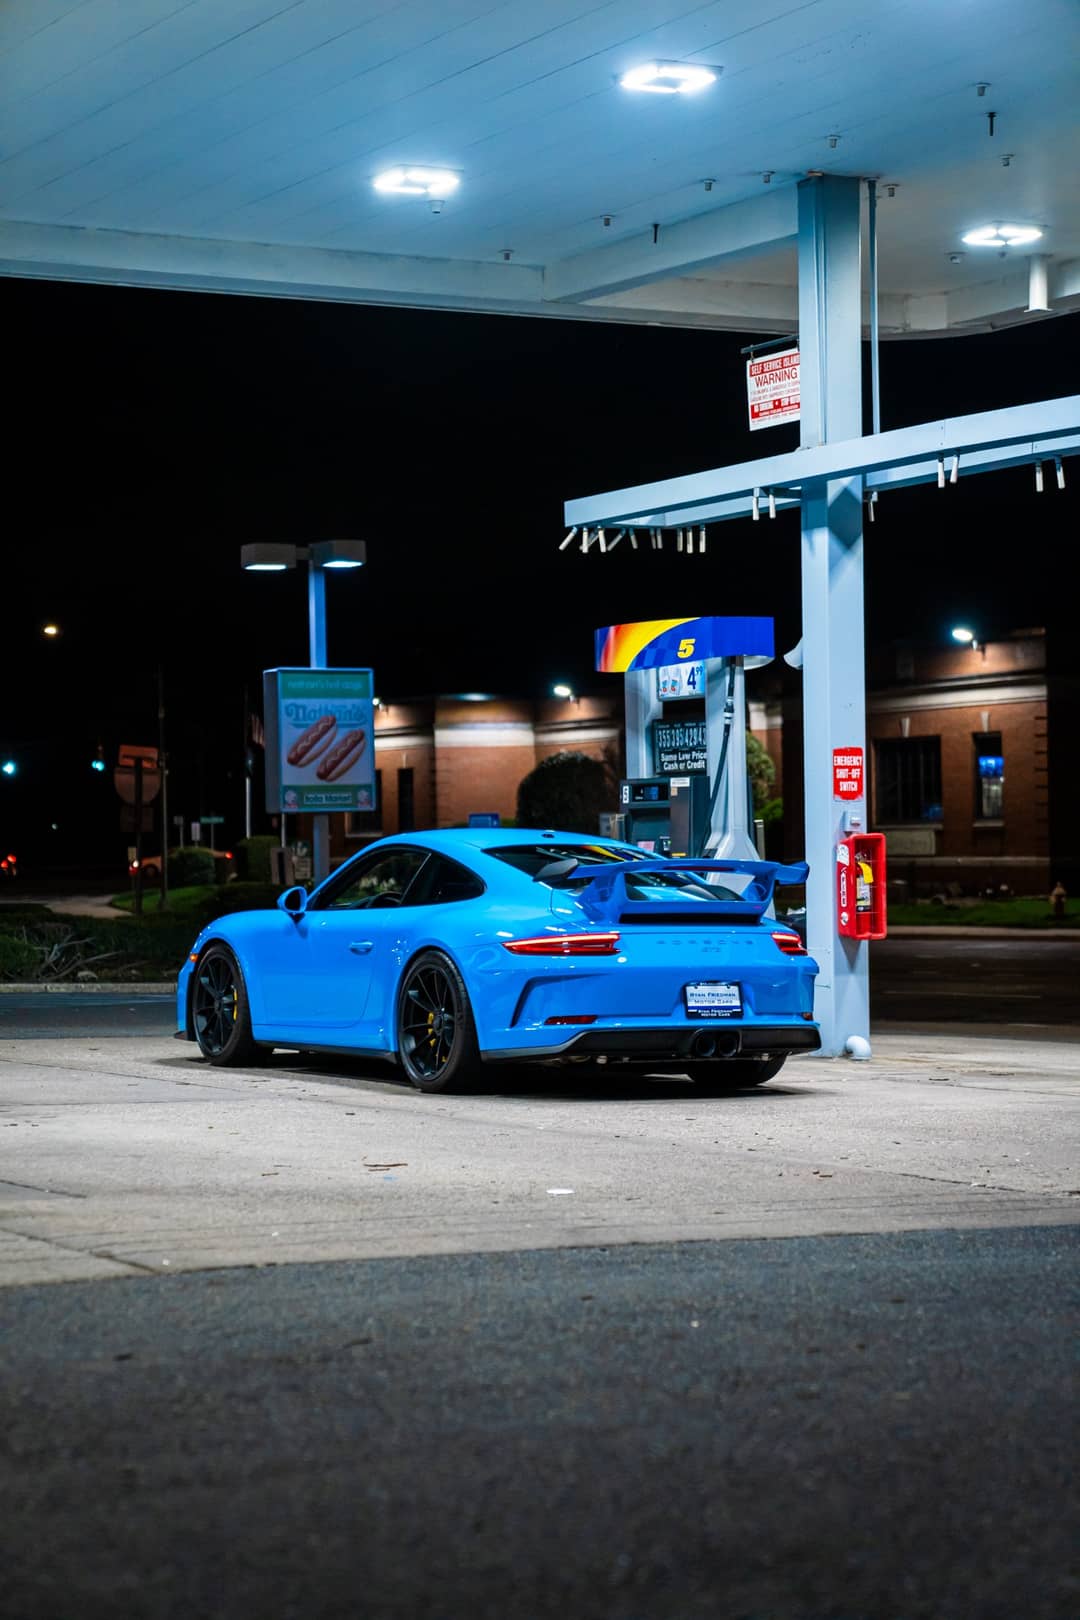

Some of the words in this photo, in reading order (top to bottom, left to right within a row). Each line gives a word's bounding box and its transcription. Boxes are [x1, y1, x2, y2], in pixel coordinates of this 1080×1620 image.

[755, 367, 798, 388] WARNING
[676, 638, 696, 659] 5
[661, 753, 677, 762] Same
[678, 751, 691, 761] Low
[833, 755, 862, 766] EMERGENCY
[663, 761, 678, 771] Cash
[679, 762, 685, 770] or
[687, 759, 705, 770] Credit
[836, 768, 860, 779] SHUT-OFF
[839, 781, 858, 792] SWITCH
